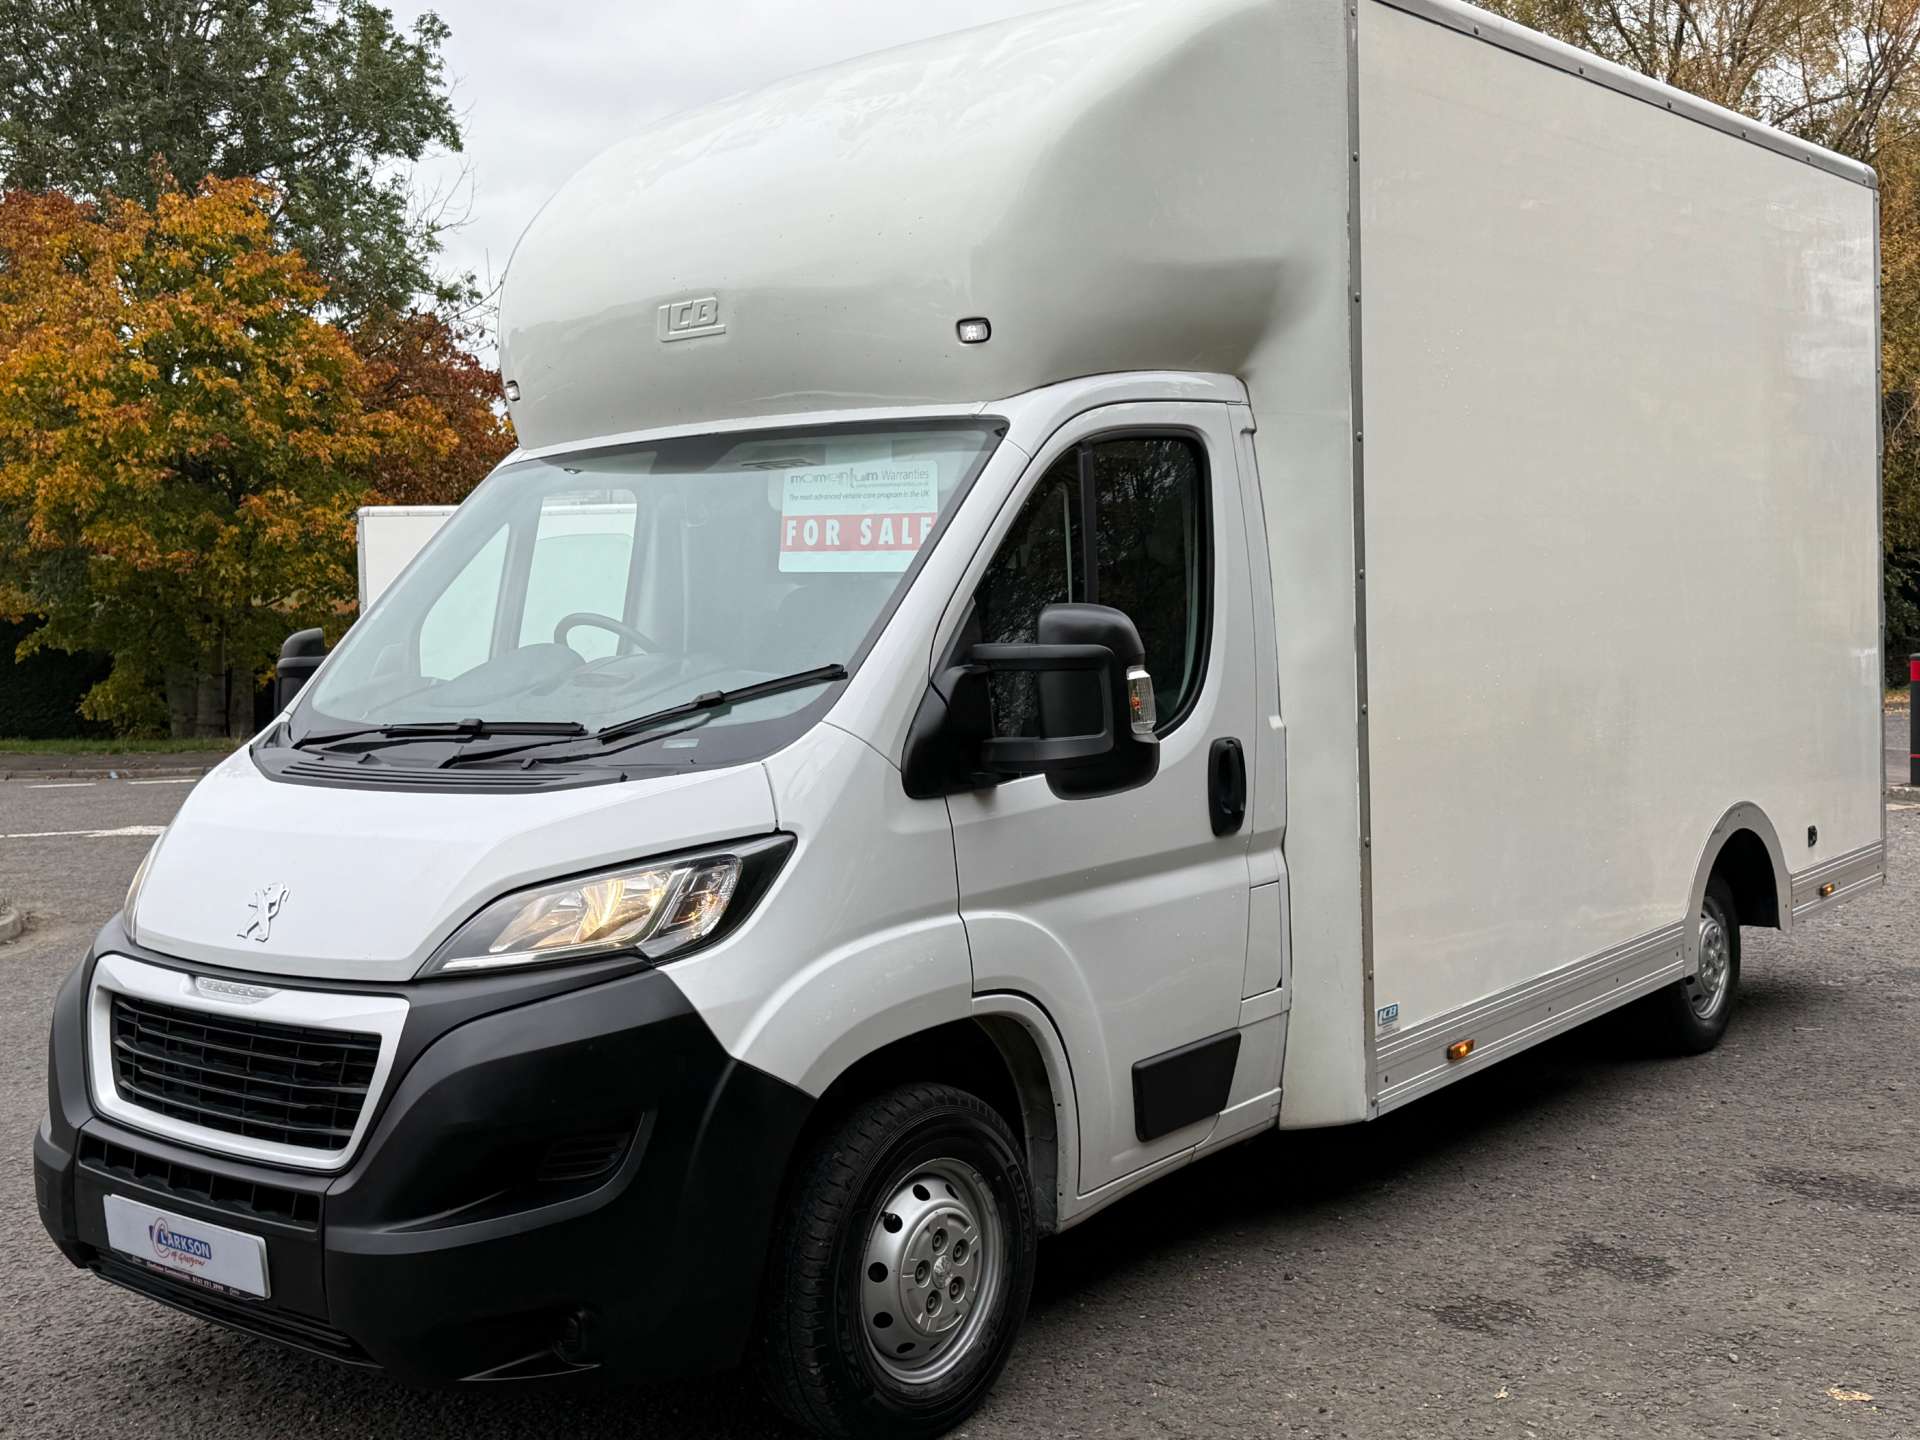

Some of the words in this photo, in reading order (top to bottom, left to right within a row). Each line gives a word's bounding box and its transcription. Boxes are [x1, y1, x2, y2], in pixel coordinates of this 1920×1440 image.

[658, 297, 726, 343] LCB
[790, 468, 878, 488] momentum
[881, 467, 929, 481] Warranties
[815, 491, 842, 500] advanced
[877, 491, 902, 500] program
[786, 519, 840, 546] FOR
[200, 978, 265, 998] PEUGEOT
[153, 1217, 210, 1259] CLARKSON
[179, 1252, 206, 1267] Glasgow
